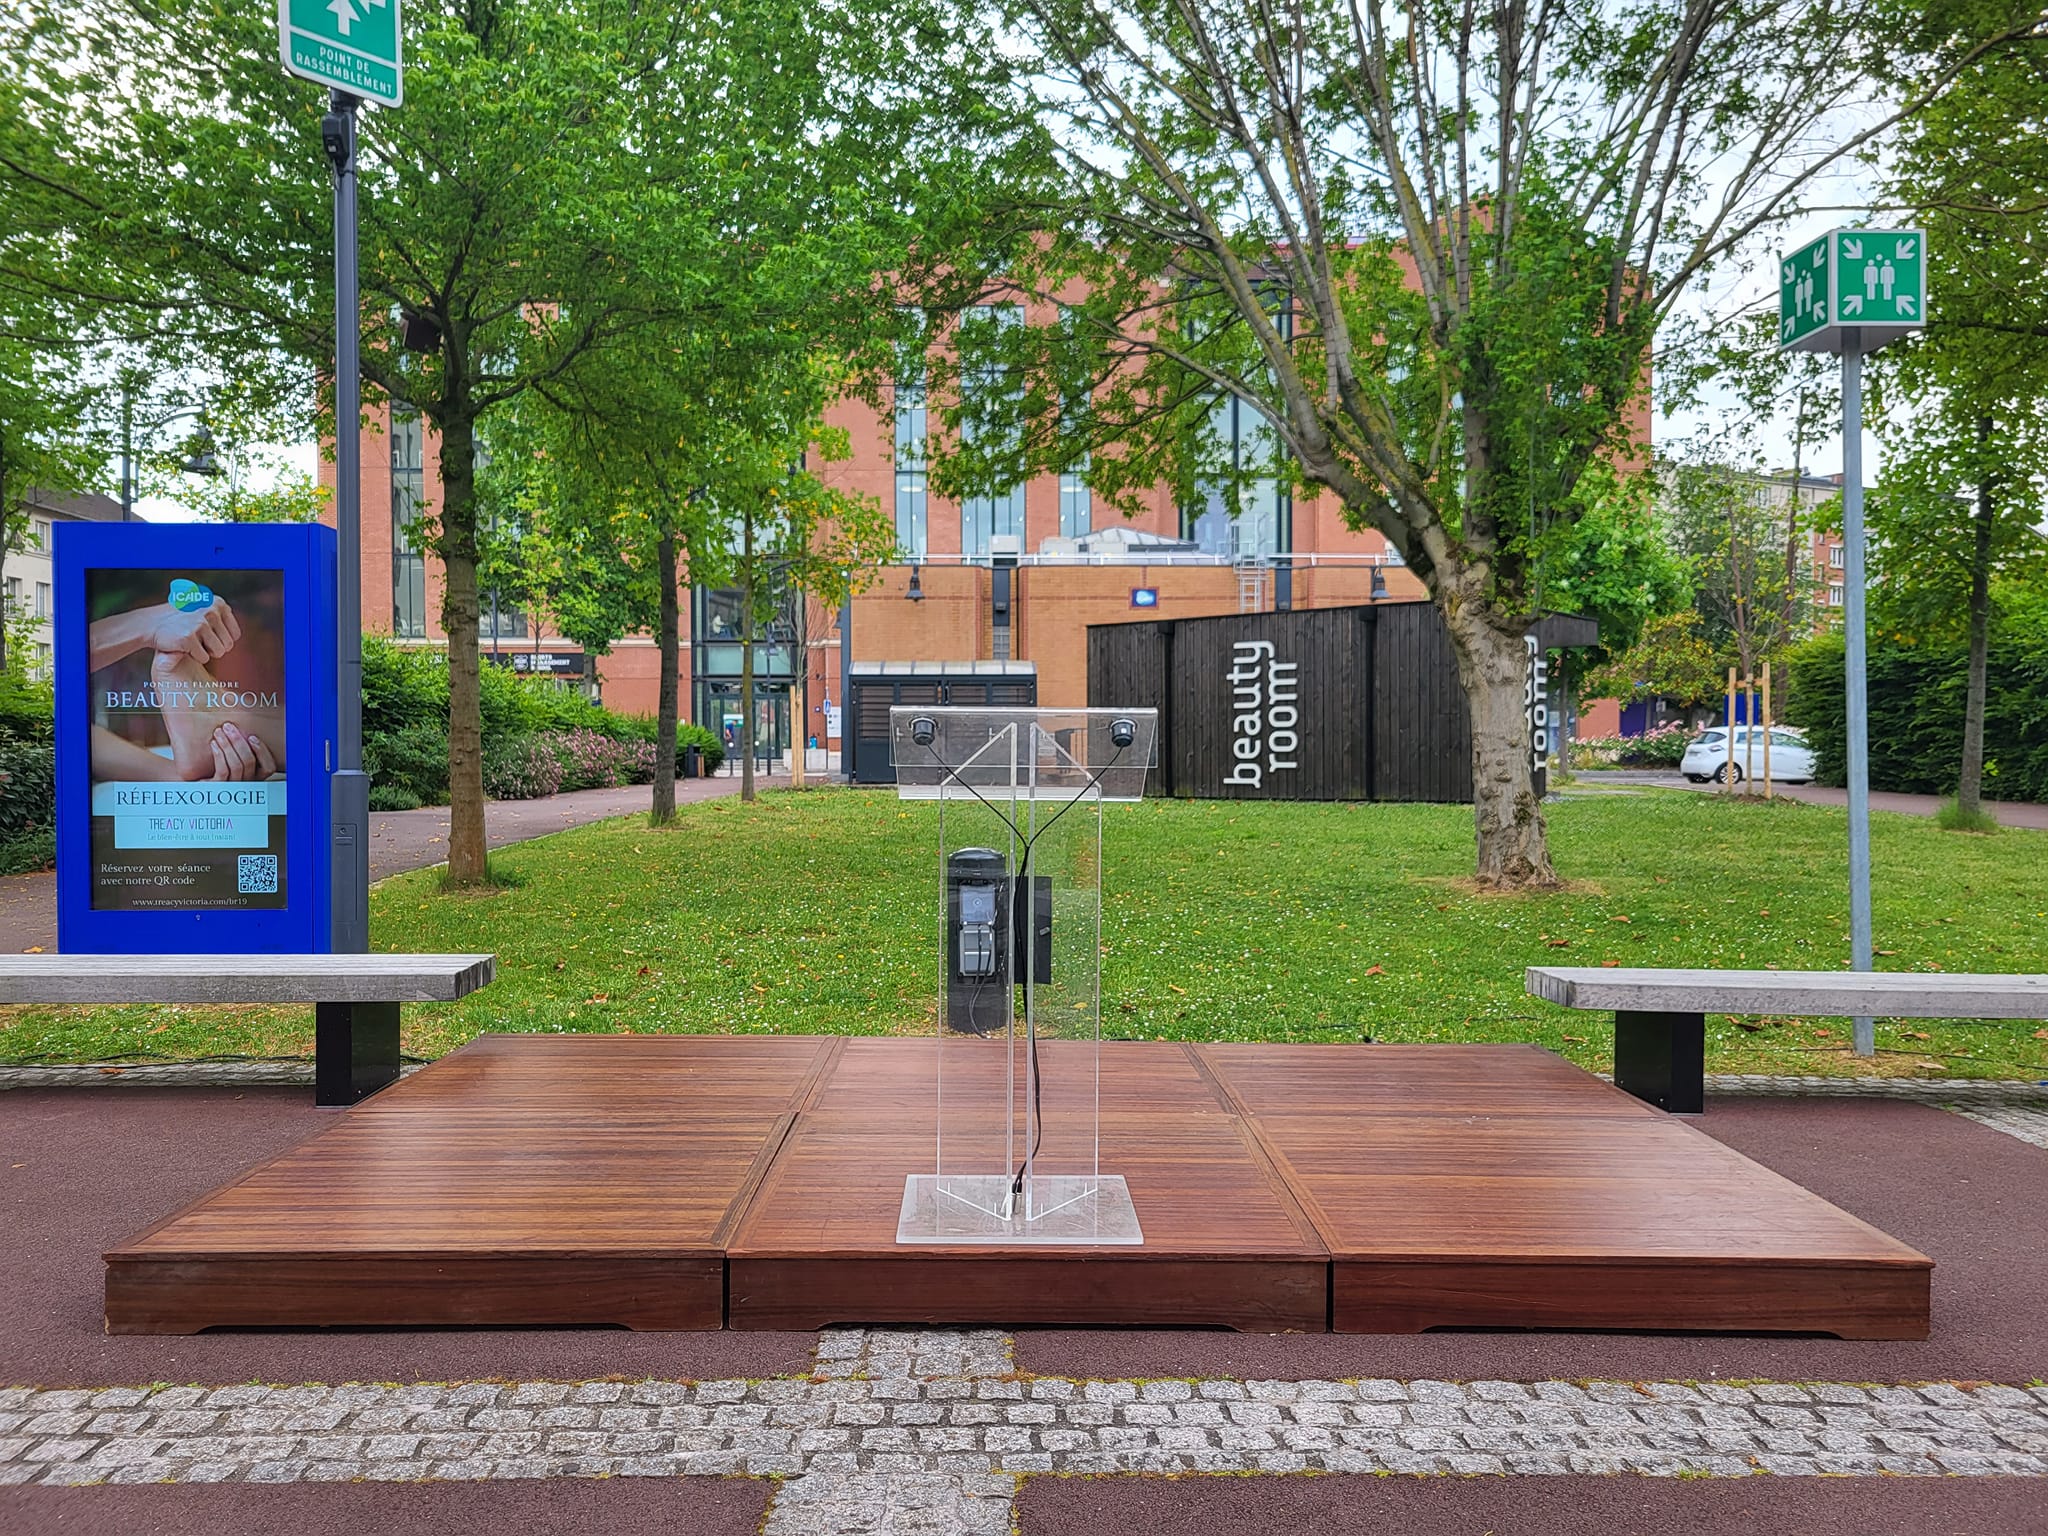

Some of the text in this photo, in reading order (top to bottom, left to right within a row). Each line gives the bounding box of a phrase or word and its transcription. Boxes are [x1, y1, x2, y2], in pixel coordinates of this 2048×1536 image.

[319, 46, 370, 74] POINT DE
[295, 52, 392, 95] RASSEMBLEMENT
[172, 591, 210, 602] ICADE
[106, 691, 278, 708] BEAUTY ROOM
[1223, 640, 1275, 789] beauty
[1268, 659, 1298, 773] room
[1533, 657, 1548, 772] room
[117, 787, 266, 805] RÉFLEXOLOGIE
[149, 818, 233, 830] TREACY VICTORIA
[100, 863, 211, 873] Réservez votre séance
[100, 875, 195, 887] avec notre QR code
